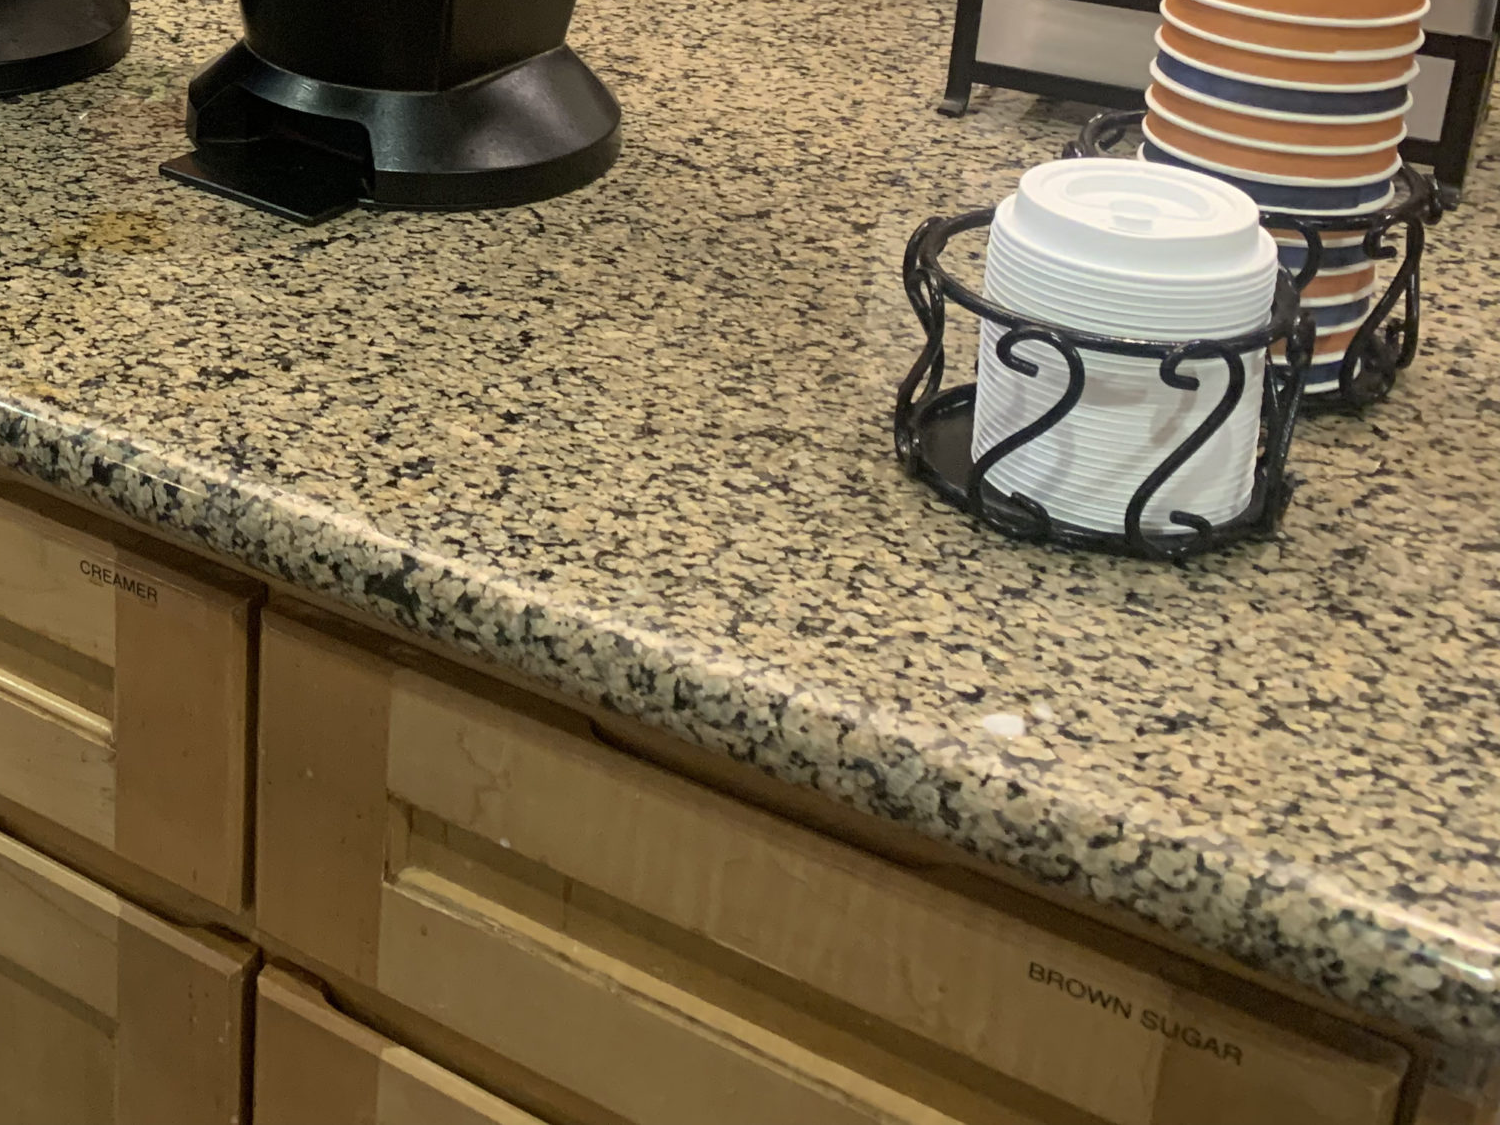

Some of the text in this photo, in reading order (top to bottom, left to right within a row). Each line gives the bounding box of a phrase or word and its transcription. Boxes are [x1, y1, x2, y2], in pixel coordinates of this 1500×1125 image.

[80, 559, 158, 603] CREAMER
[1028, 961, 1244, 1066] BROWN SUGAR
